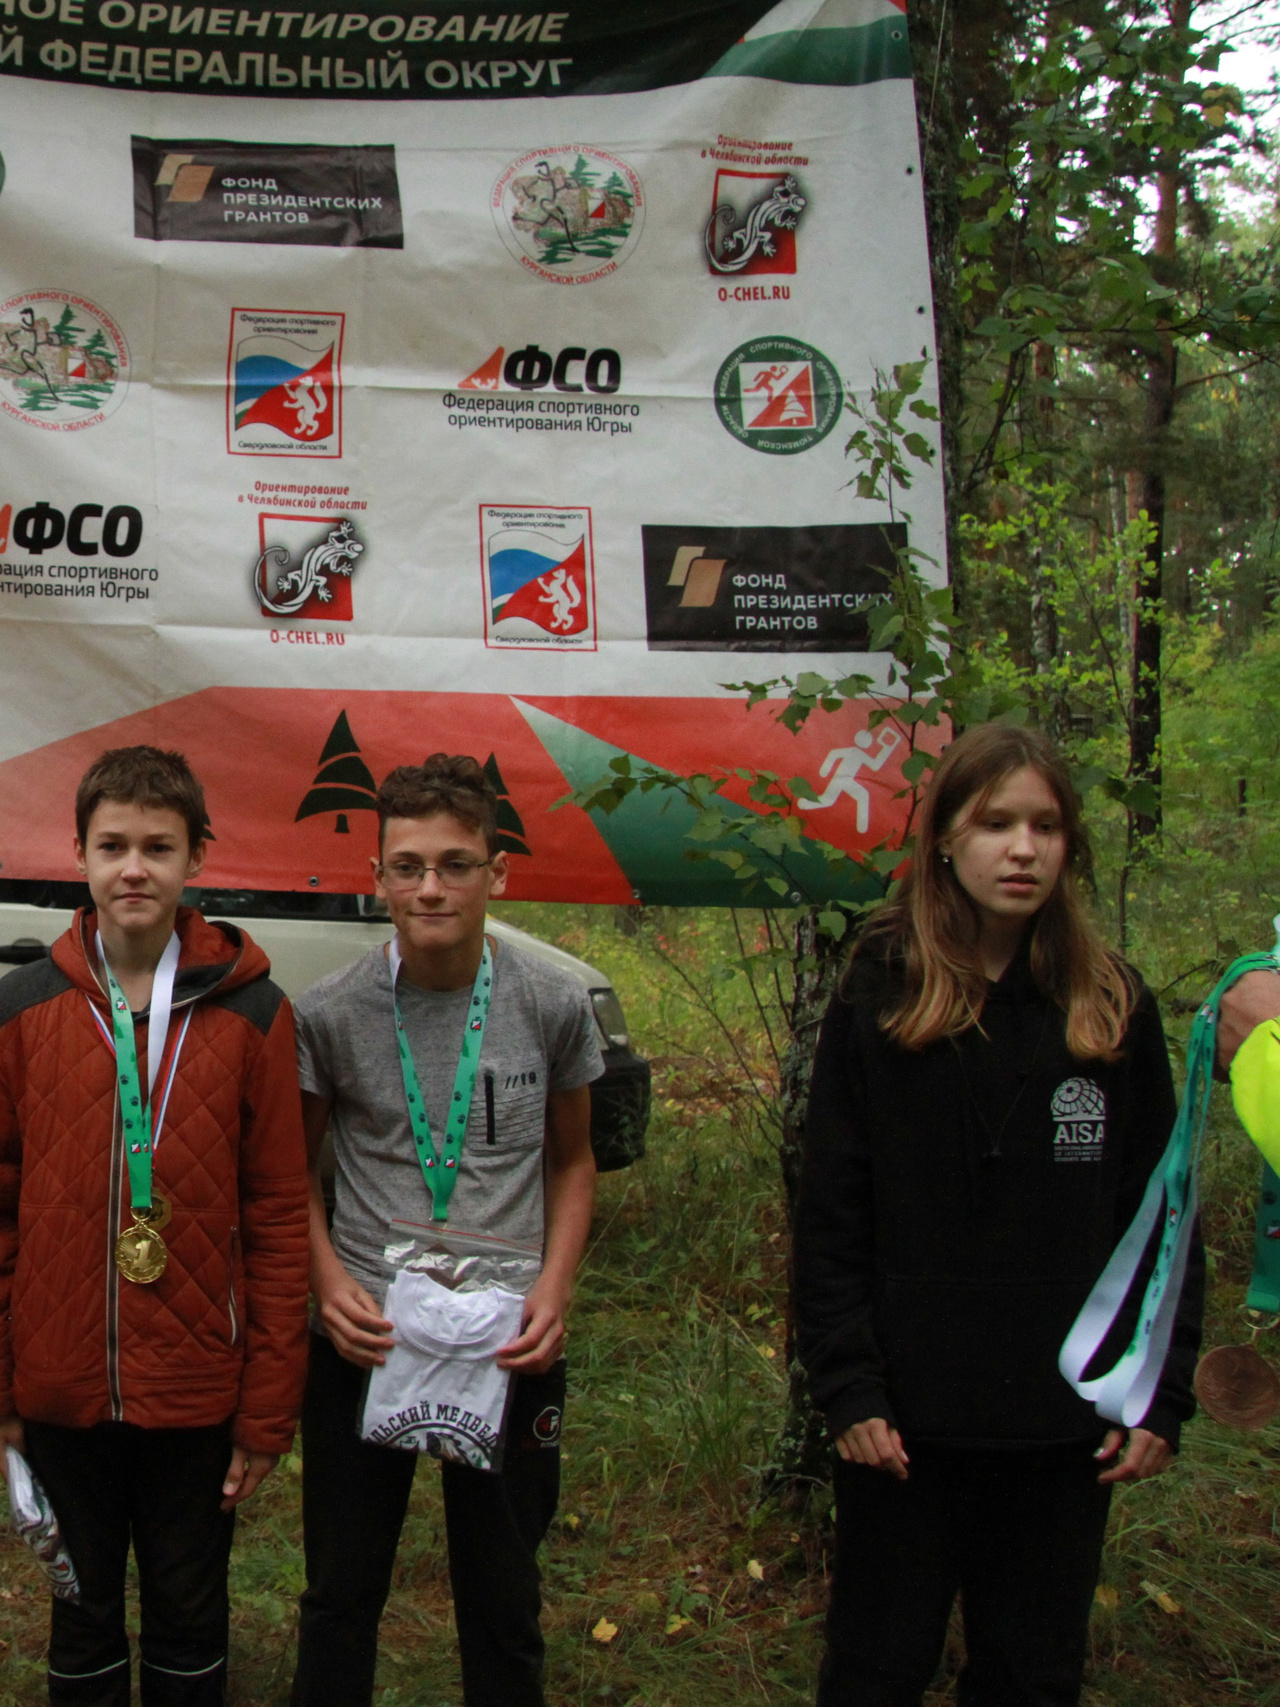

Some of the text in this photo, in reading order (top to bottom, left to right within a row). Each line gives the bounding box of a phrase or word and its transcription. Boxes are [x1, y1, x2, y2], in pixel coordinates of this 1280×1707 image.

[99, 0, 569, 43] ОРИЕНТИРОВАНИЕ
[39, 38, 410, 89] ФЕДЕРАЛЬНЫЙ
[425, 57, 573, 89] ОКРУГ
[221, 177, 278, 191] ФОНД
[222, 192, 382, 210] ПРЕЗИДЕНТСКИХ
[223, 210, 309, 223] ГРАНТОВ
[718, 285, 790, 301] O-CHEL.RU
[503, 344, 621, 394] ФСО
[442, 392, 640, 417] Федерация спортивного
[448, 414, 632, 436] ориентирования Югры
[254, 481, 350, 496] Ориентирование
[247, 494, 317, 509] Челябинской
[319, 497, 368, 510] области
[13, 502, 143, 557] ФСО
[48, 564, 159, 582] спортивного
[732, 573, 787, 590] ФОНД
[100, 582, 150, 602] Югры
[735, 616, 818, 630] ГРАНТОВ
[270, 629, 346, 645] O-CHEL.RU
[1053, 1122, 1105, 1144] AISA
[366, 1400, 431, 1444] ЛЬСКИЙ
